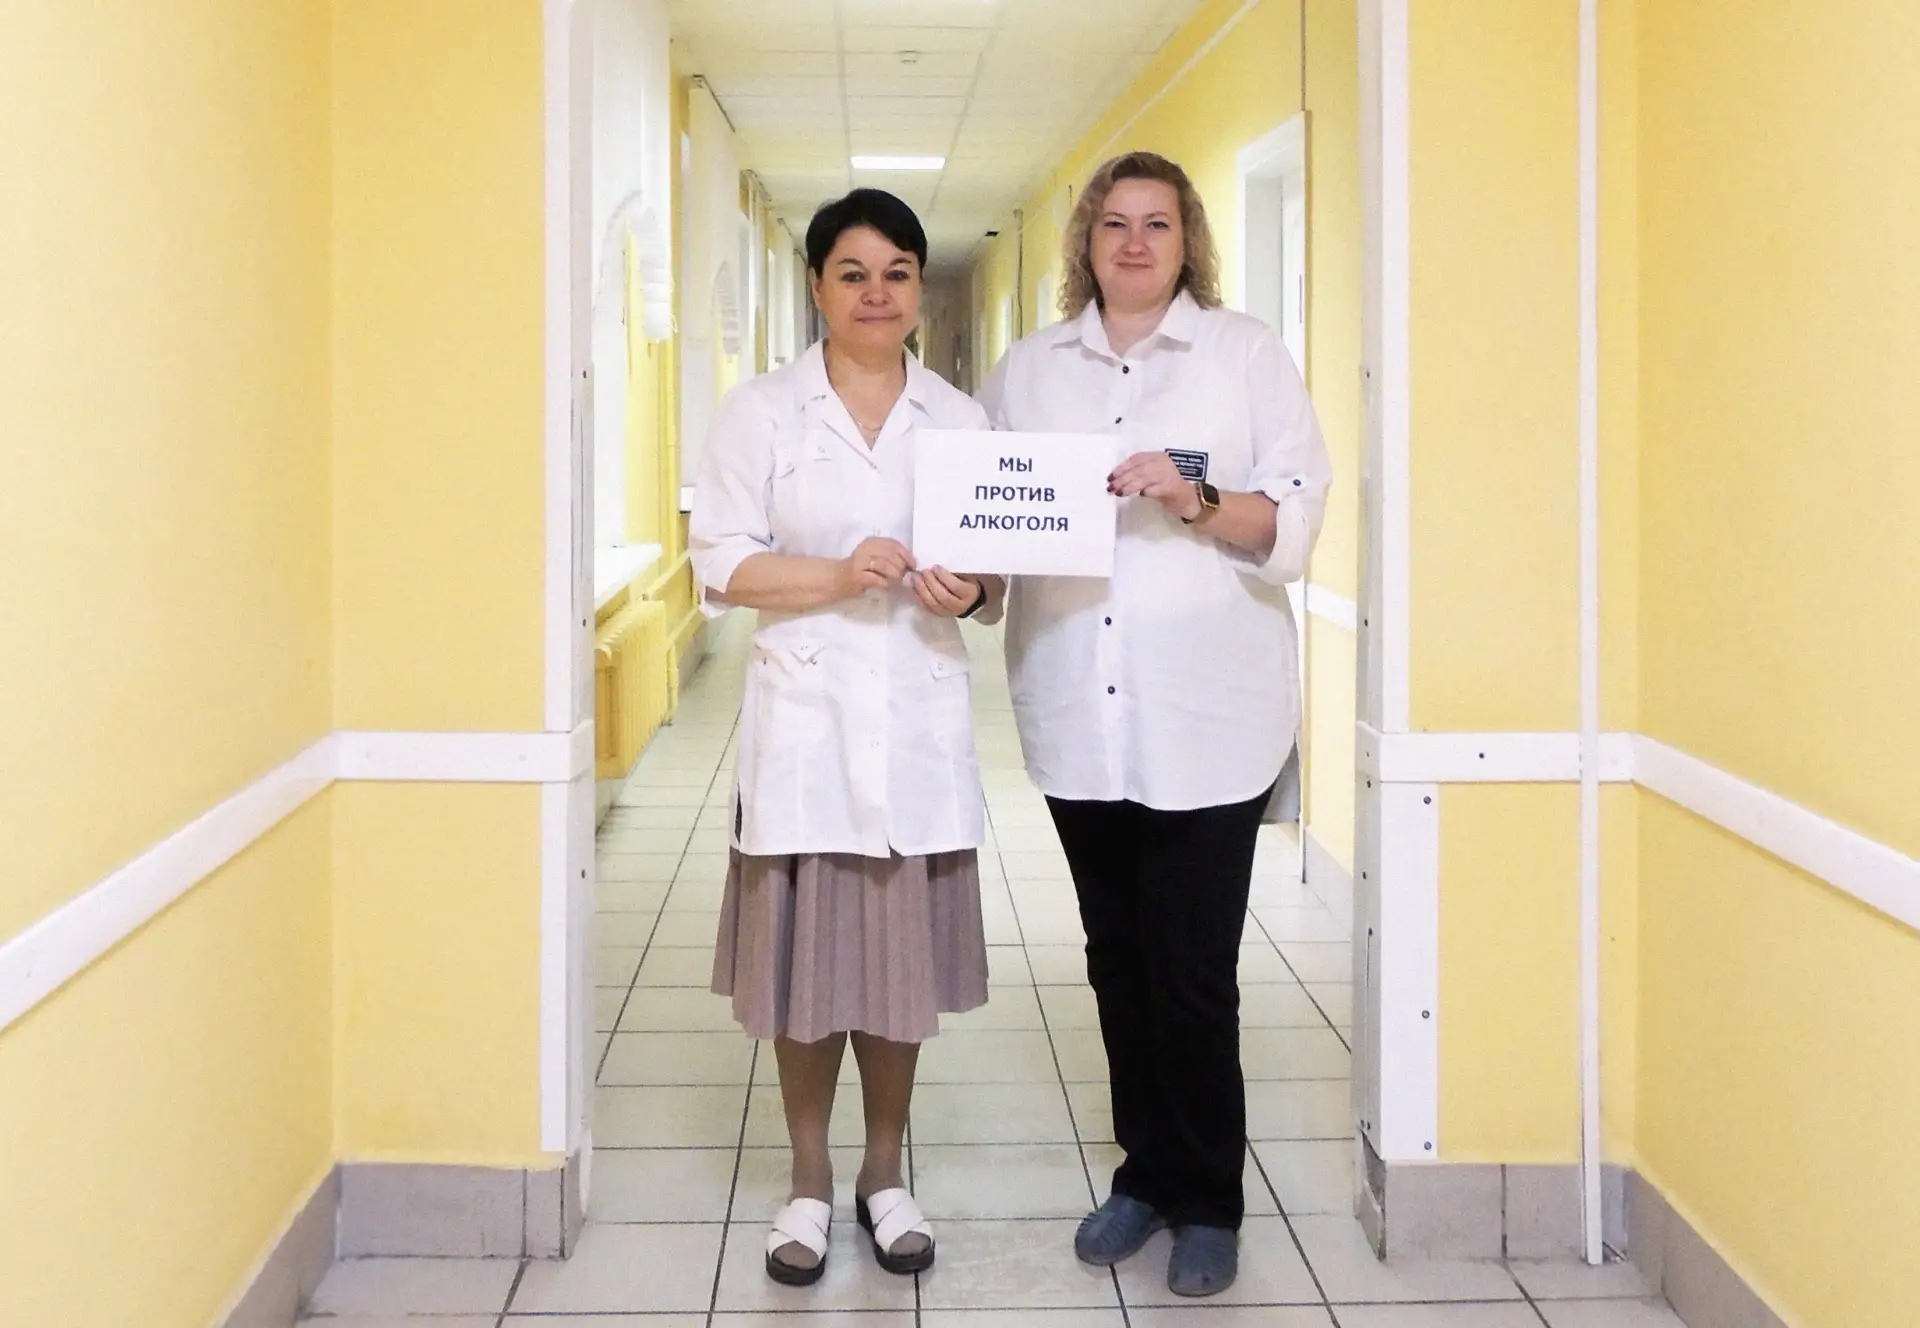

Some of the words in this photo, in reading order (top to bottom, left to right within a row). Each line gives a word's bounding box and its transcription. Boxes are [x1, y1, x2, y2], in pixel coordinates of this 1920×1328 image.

[999, 457, 1033, 472] МЫ
[975, 486, 1056, 502] ПРОТИВ
[959, 514, 1069, 531] АЛКОГОЛЯ
